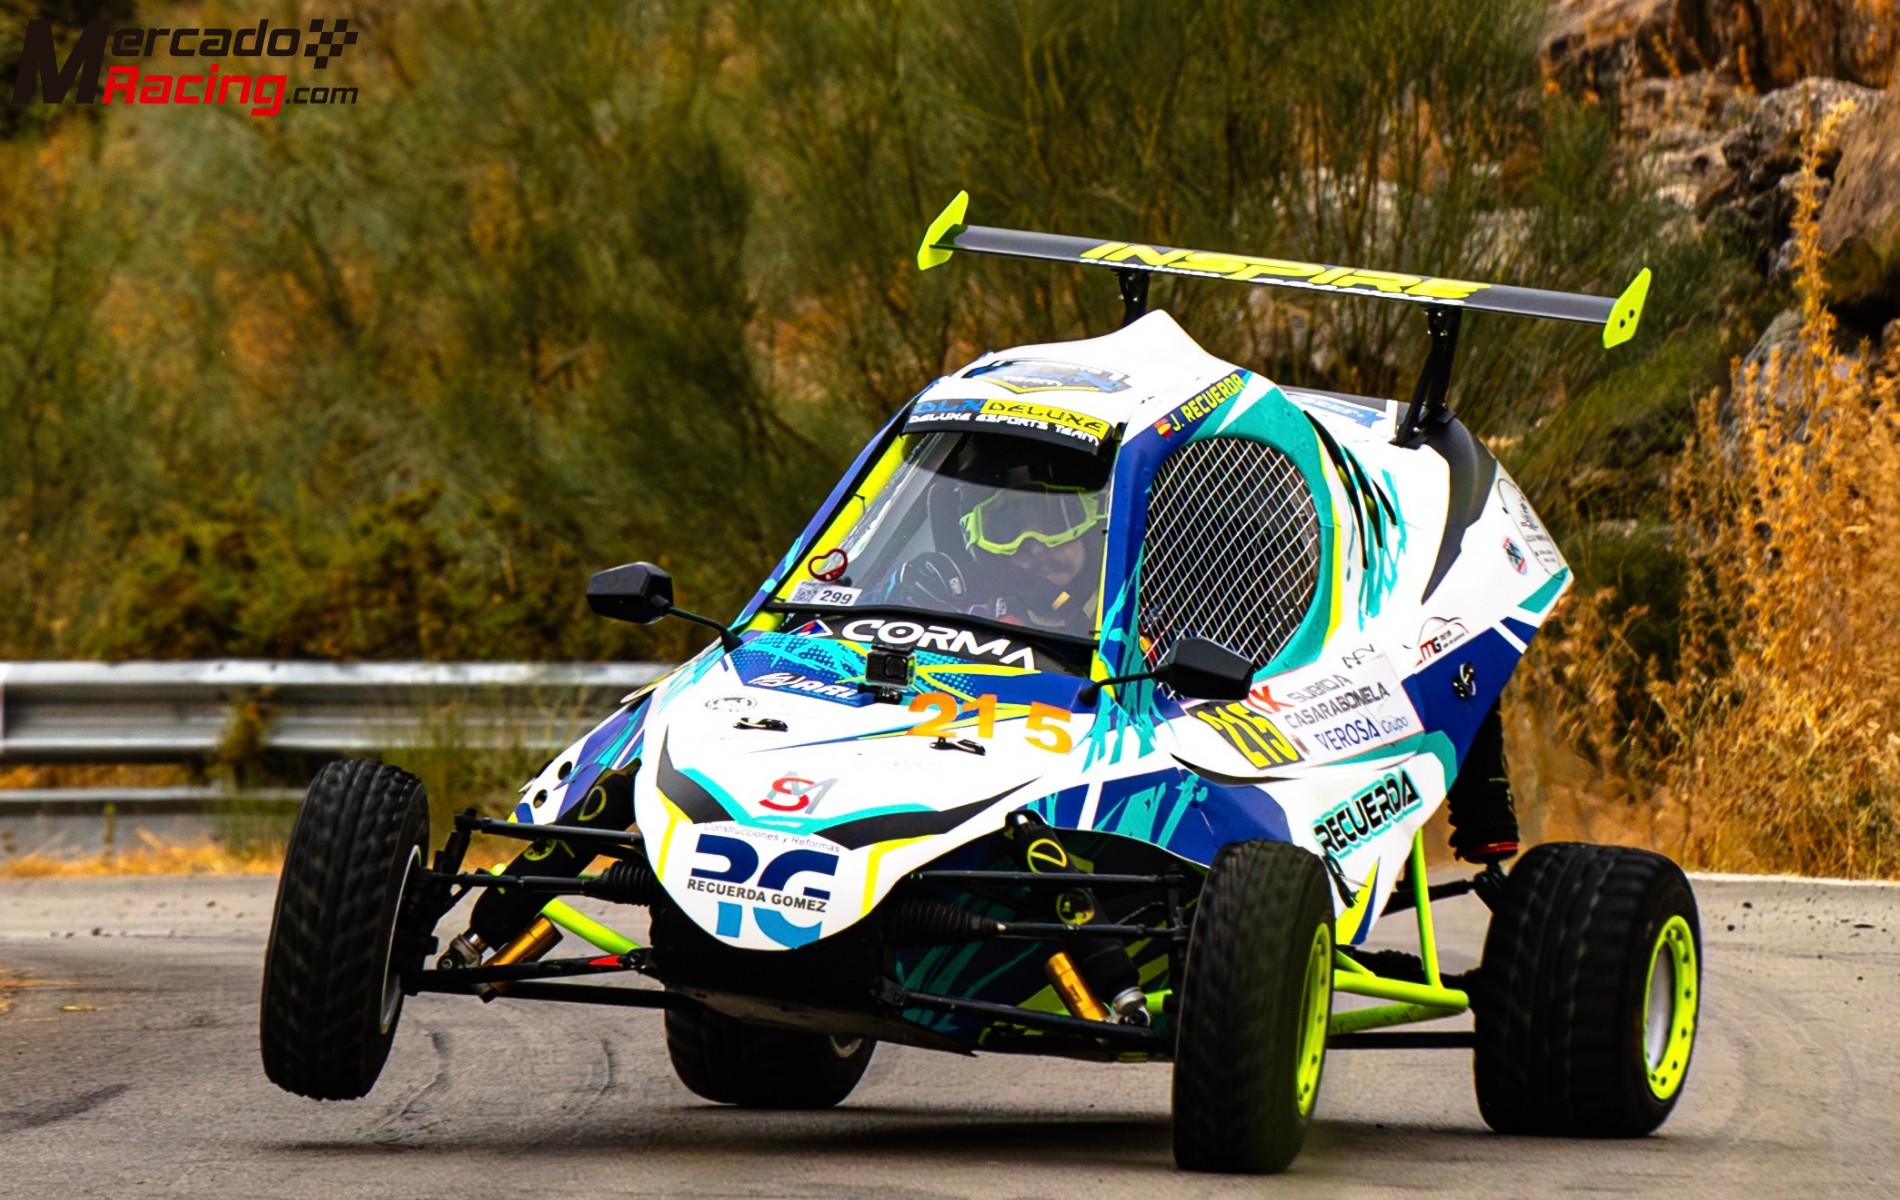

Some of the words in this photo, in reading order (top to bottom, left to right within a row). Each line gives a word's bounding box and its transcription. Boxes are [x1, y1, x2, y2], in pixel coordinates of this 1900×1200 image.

[1080, 241, 1492, 299] INSPIRE
[987, 401, 1103, 434] DELUXE
[1169, 412, 1186, 432] J.
[1180, 372, 1246, 422] RECUERDA
[908, 412, 972, 424] DELUXE
[975, 413, 1049, 431] ESPORTS
[1054, 424, 1100, 447] TEAM
[819, 589, 854, 606] 299
[841, 618, 1036, 672] CORMA
[1283, 681, 1391, 729] CASARABONELA
[1286, 674, 1354, 703] SUBIDA
[1196, 701, 1300, 768] 215
[1313, 717, 1381, 752] VEROSA
[1312, 768, 1421, 854] RECUERDA
[703, 822, 780, 842] Construcciones
[781, 835, 789, 844] y
[790, 836, 841, 853] Reformas
[687, 878, 767, 904] RECUERDA
[770, 892, 828, 914] GOMEZ
